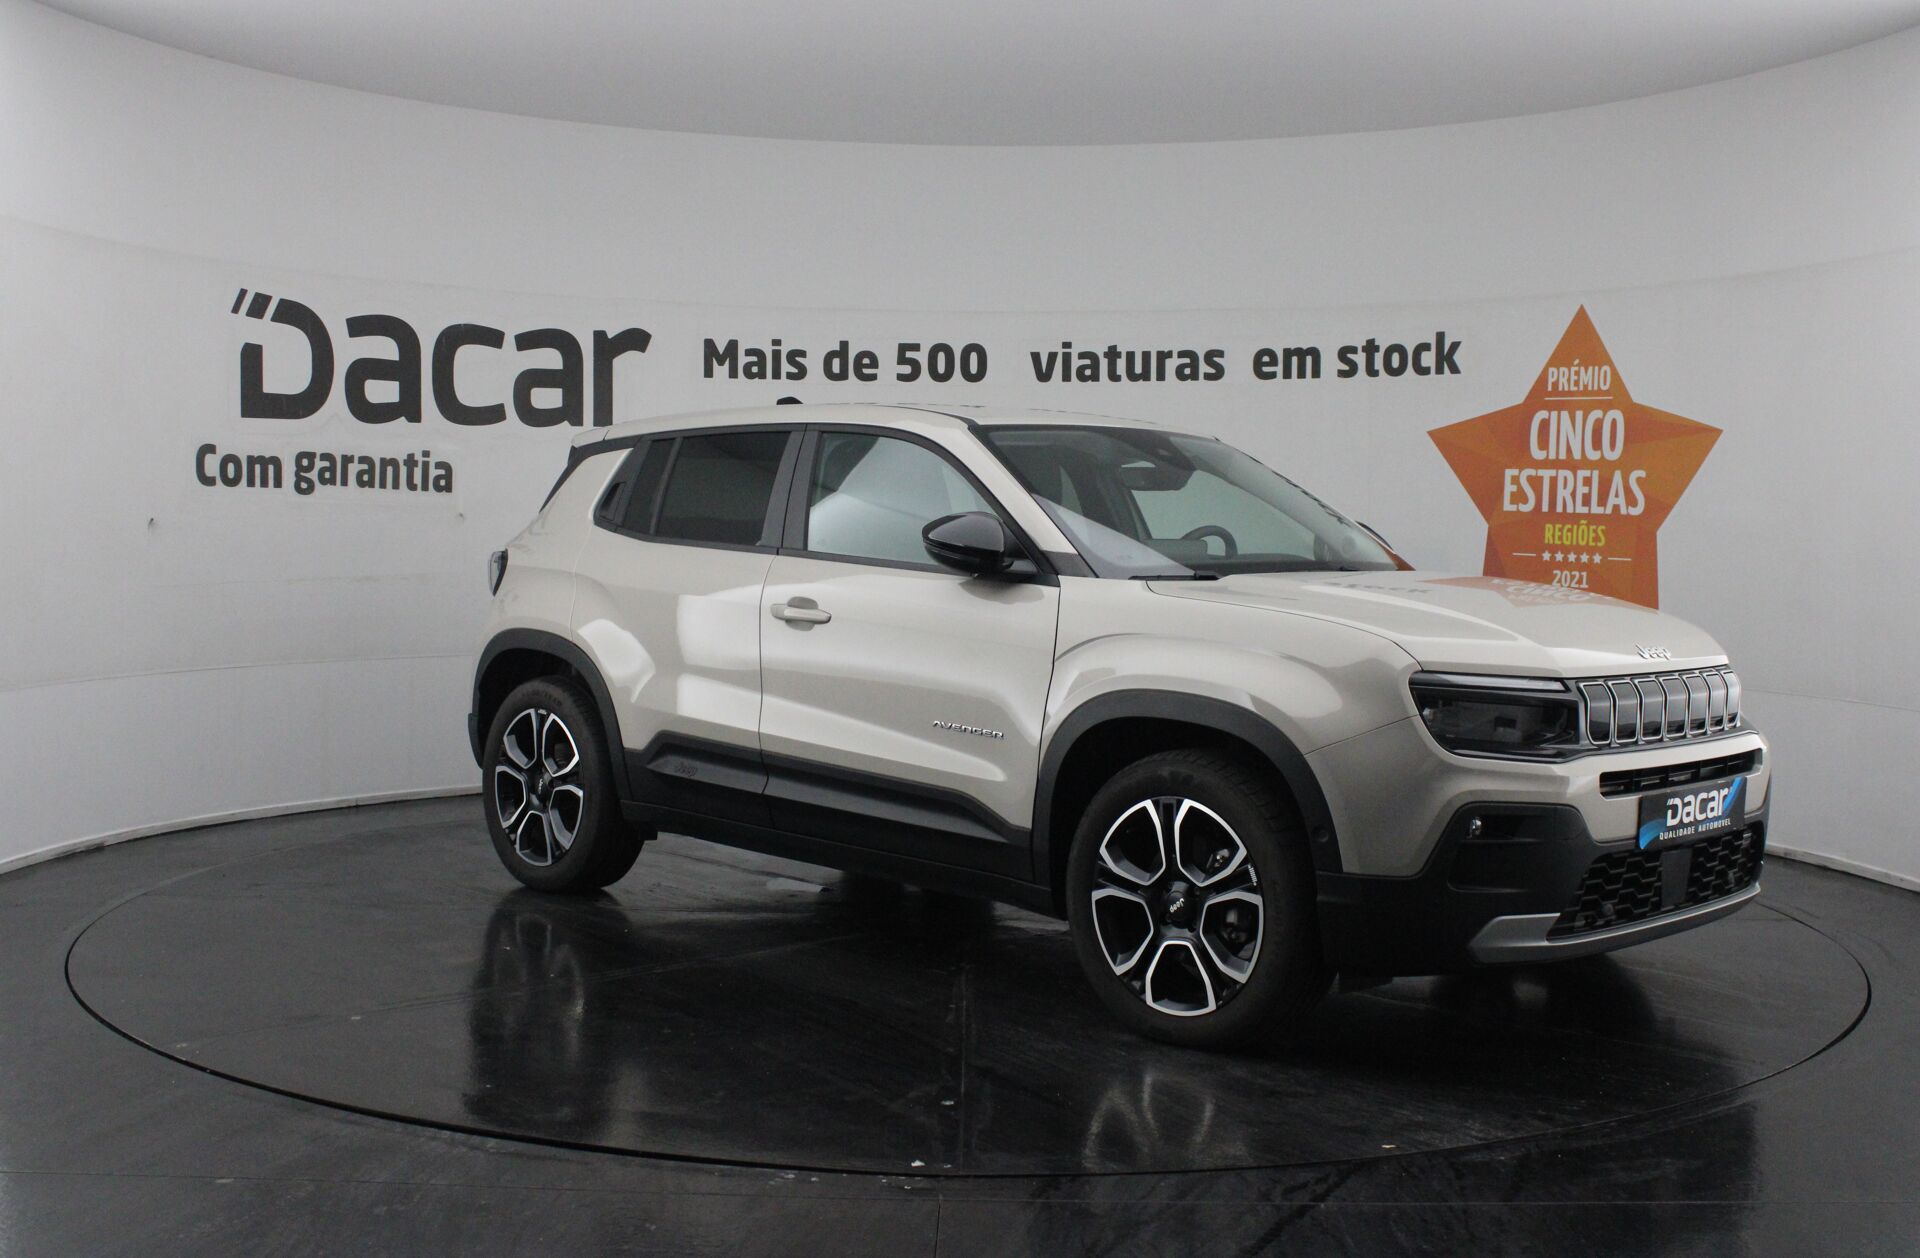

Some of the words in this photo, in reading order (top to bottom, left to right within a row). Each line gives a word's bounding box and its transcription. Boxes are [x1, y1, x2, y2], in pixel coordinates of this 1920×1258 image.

[231, 288, 652, 427] Dacar
[703, 338, 807, 381] Mais
[823, 340, 879, 382] de
[896, 342, 988, 383] 500
[1030, 341, 1226, 383] viaturas
[1252, 346, 1321, 380] em
[1336, 331, 1462, 378] stock
[1547, 359, 1611, 391] PRÉMIO
[1529, 409, 1625, 461] CINCO
[195, 443, 283, 488] Com
[293, 449, 454, 496] garantia
[1502, 468, 1647, 516] ESTRELAS
[1544, 520, 1606, 547] REGIÕES
[1552, 570, 1589, 588] 2021
[932, 720, 1005, 739] AVENGER
[1666, 787, 1729, 826] Dacar
[1659, 826, 1695, 840] QUALIDADE
